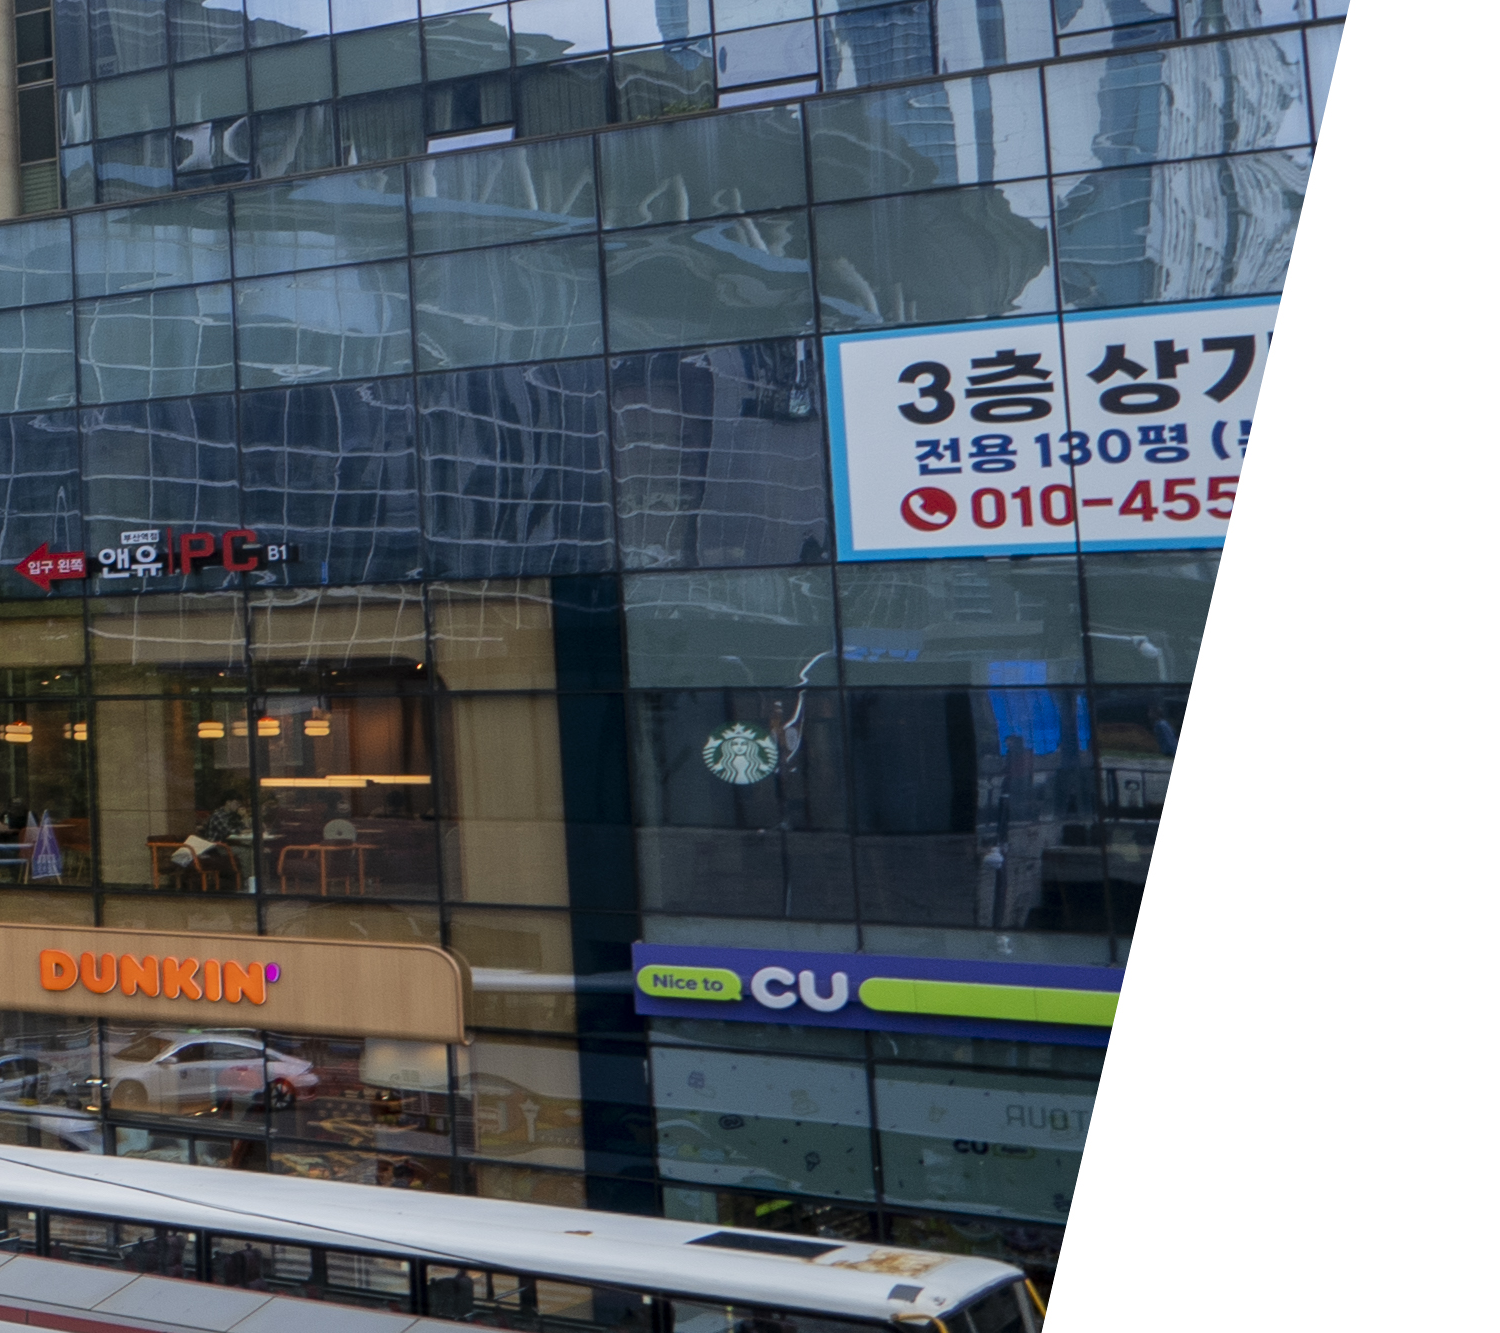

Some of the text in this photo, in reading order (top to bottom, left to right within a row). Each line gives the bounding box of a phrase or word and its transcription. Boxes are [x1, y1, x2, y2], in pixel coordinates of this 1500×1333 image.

[897, 349, 1055, 426] 3층
[915, 433, 1018, 476] 전용
[1033, 423, 1191, 468] 130평
[27, 557, 84, 575] 입구 왼쪽
[98, 529, 288, 579] 앤유 PC B1
[652, 966, 849, 1013] Nice to CU
